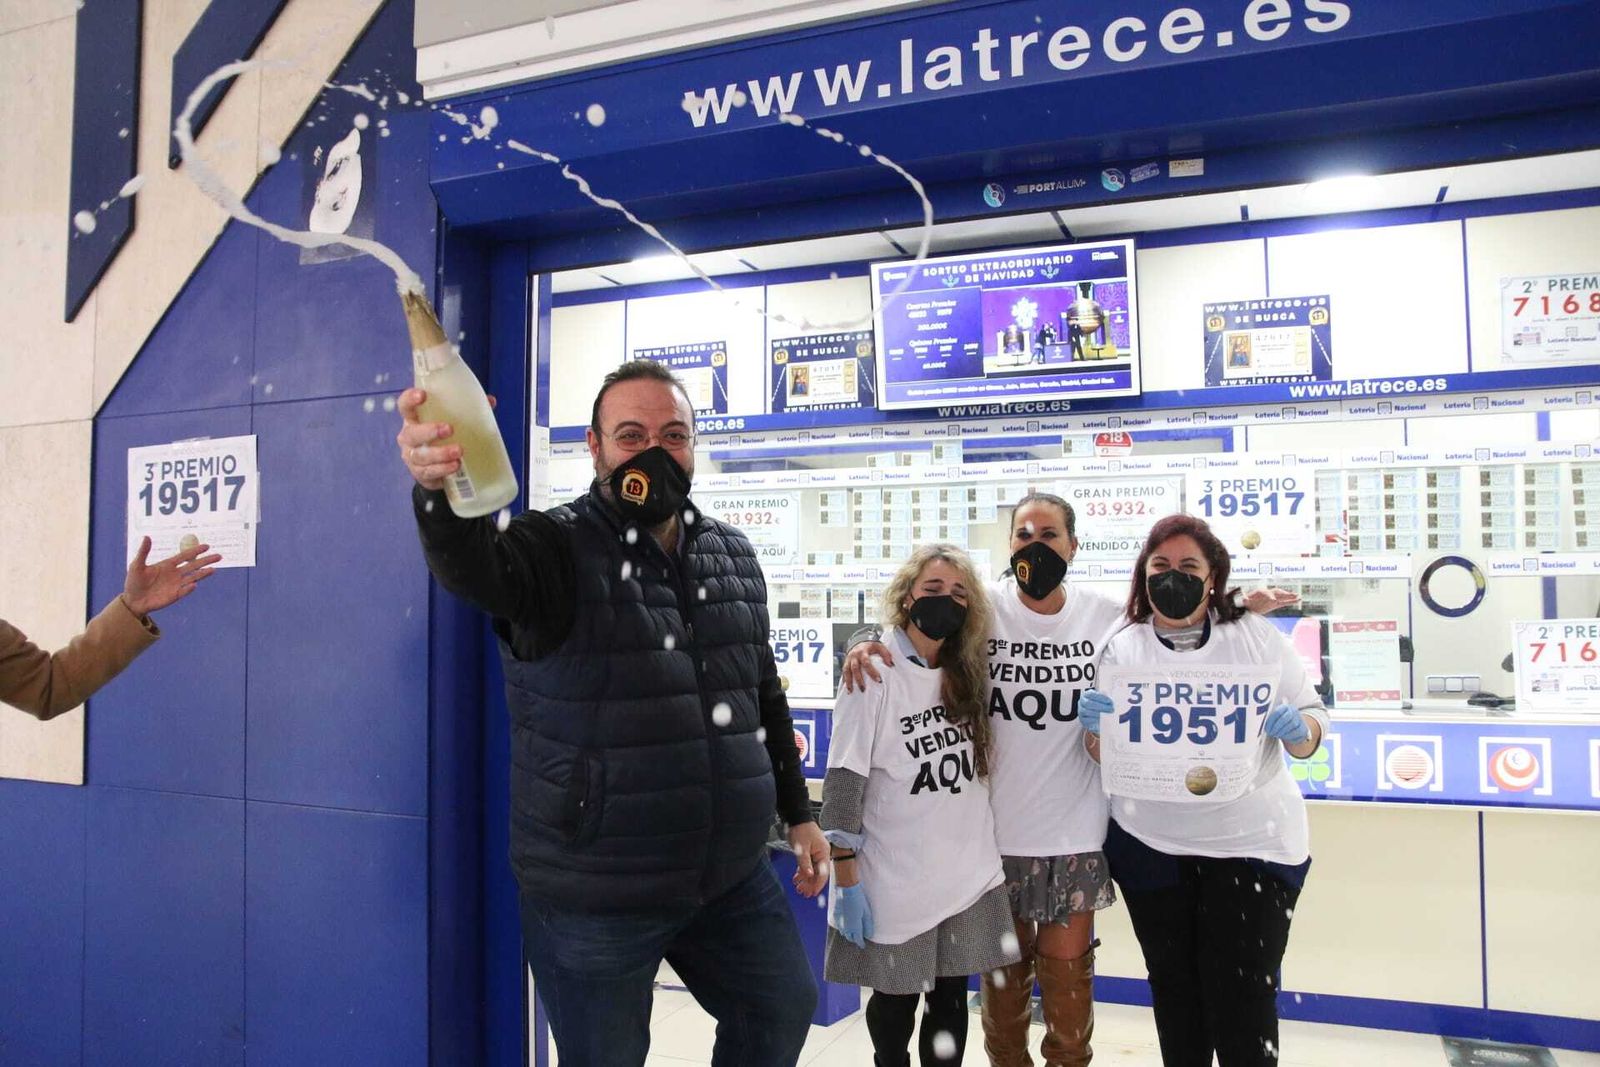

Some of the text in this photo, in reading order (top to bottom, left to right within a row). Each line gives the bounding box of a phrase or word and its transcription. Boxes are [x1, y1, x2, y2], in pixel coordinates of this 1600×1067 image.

[684, 0, 1351, 128] www.latrece.es
[923, 265, 966, 276] SORTEO
[971, 255, 1074, 272] EXTRAORDINARIO
[965, 269, 1034, 283] DE NAVIDAD
[1204, 298, 1326, 312] www.latrece.es
[1513, 292, 1600, 317] 7168
[1255, 312, 1296, 322] BUSCA
[772, 333, 870, 348] www.latrece.es
[634, 342, 724, 357] www.latrece.es
[813, 346, 846, 355] BUSCA
[672, 356, 702, 365] BUSCA
[1289, 378, 1447, 398] www.latrece.es
[161, 454, 236, 480] PREMIO
[630, 481, 640, 494] 13
[1074, 486, 1165, 498] GRAN PREMIO
[1220, 478, 1296, 492] PREMIO
[139, 475, 246, 517] 19517
[713, 498, 789, 510] GRAN PREMIO
[1086, 501, 1145, 516] 33.932
[1198, 492, 1304, 517] 19517
[723, 512, 772, 525] 33.932
[1078, 541, 1129, 551] VENDIDO
[769, 629, 818, 641] REMIO
[1564, 626, 1600, 638] PRE
[774, 642, 824, 663] 517
[1010, 640, 1094, 660] PREMIO
[1530, 642, 1597, 662] 716
[989, 662, 1095, 683] VENDIDO
[1155, 683, 1272, 705] PREMIO
[988, 683, 1095, 730] AQU
[905, 722, 974, 759] VENDI
[910, 749, 976, 795] AQU
